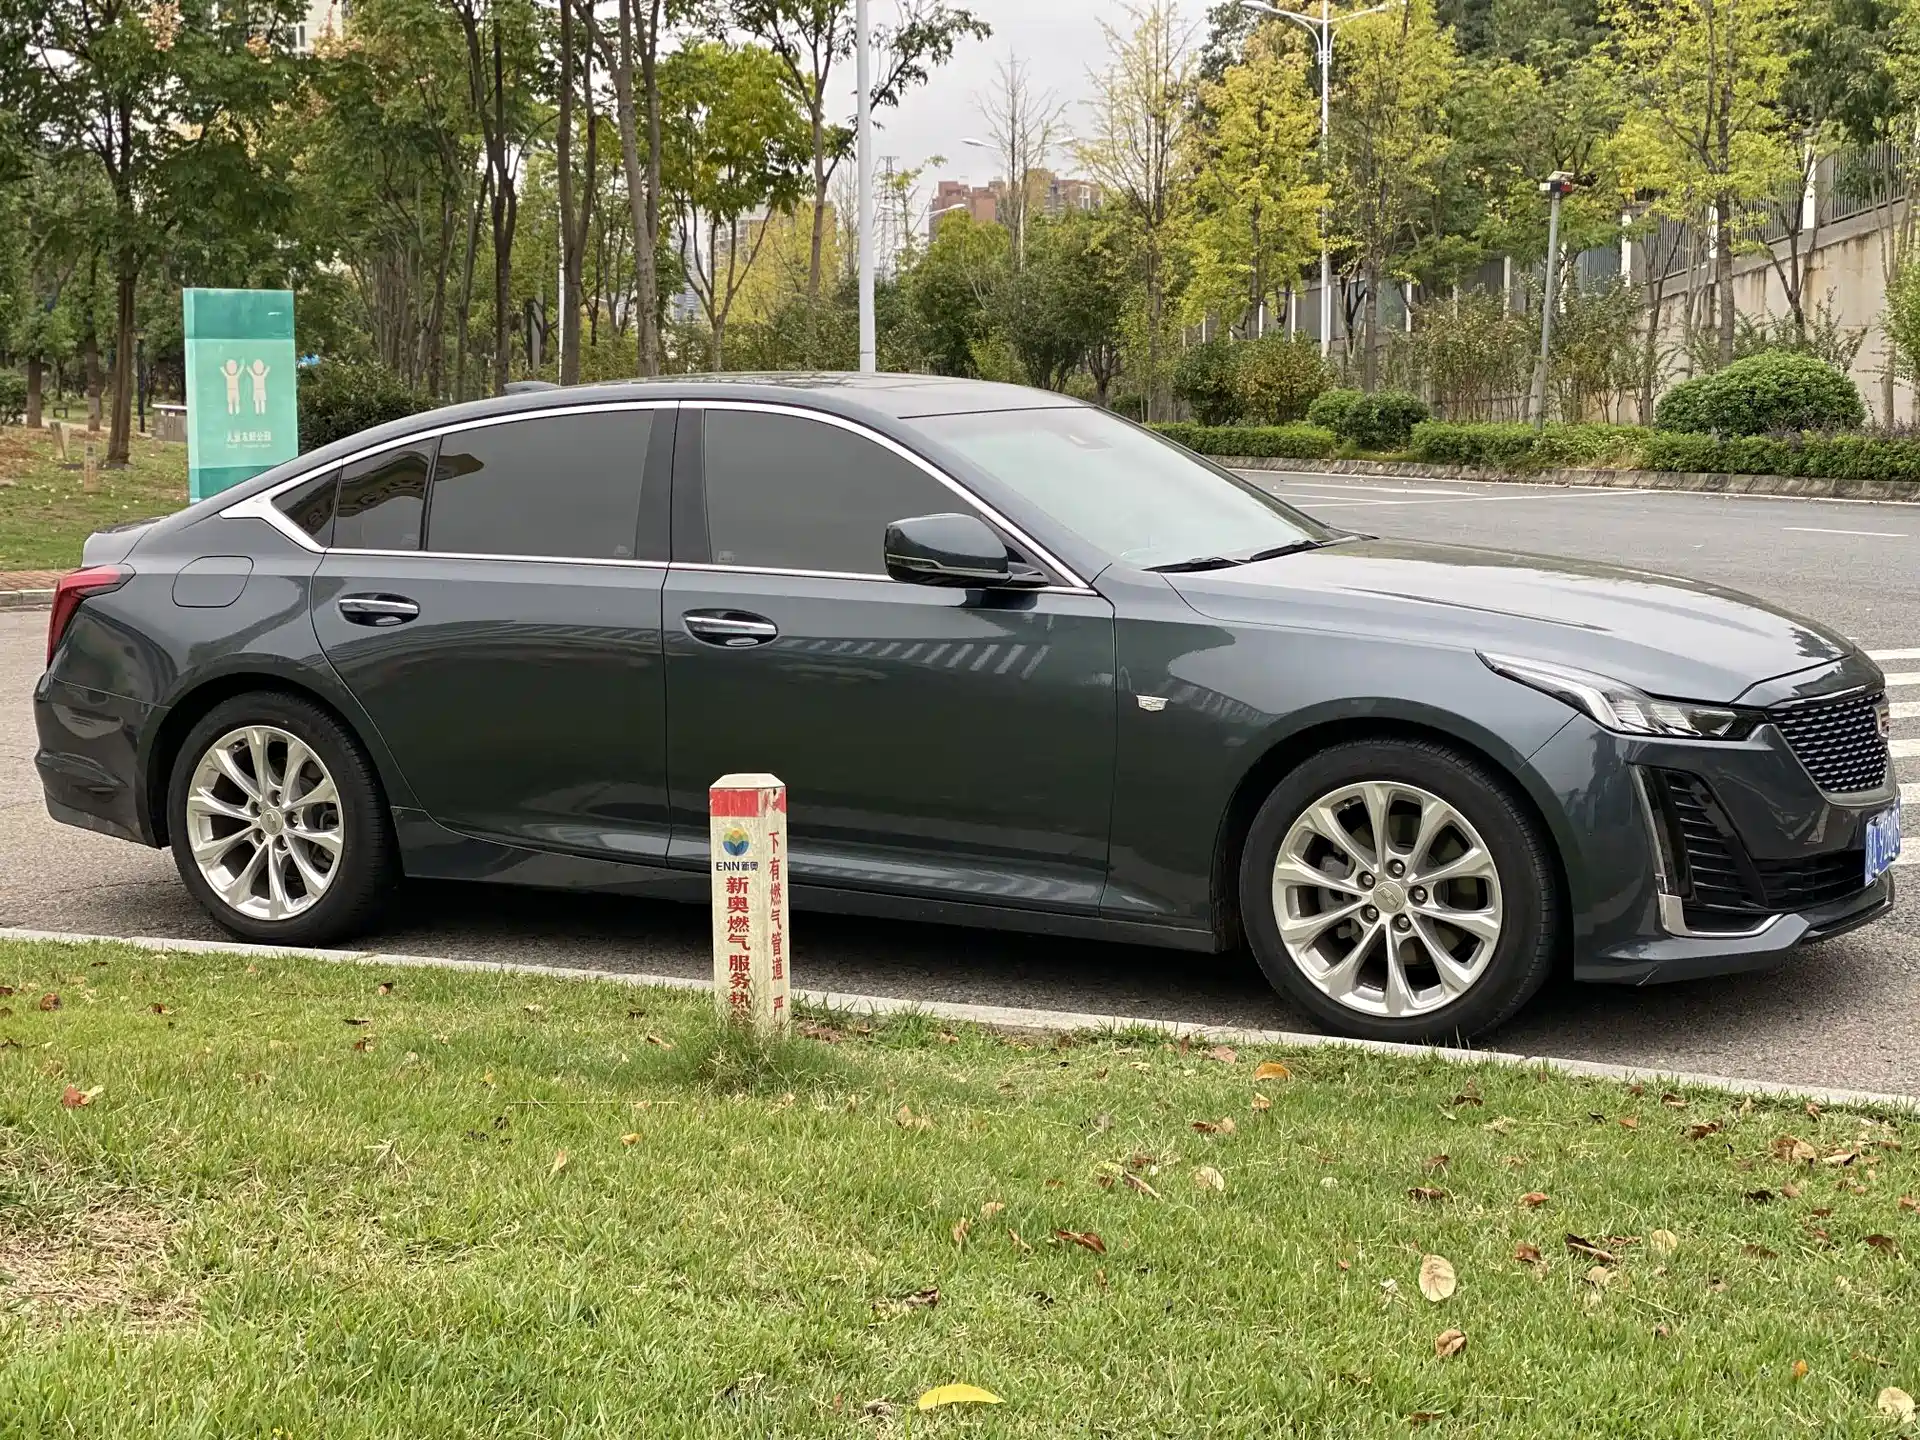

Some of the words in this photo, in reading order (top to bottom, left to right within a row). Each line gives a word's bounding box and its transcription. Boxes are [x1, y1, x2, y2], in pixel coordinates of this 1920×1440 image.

[768, 831, 783, 981] 下有燃气管道
